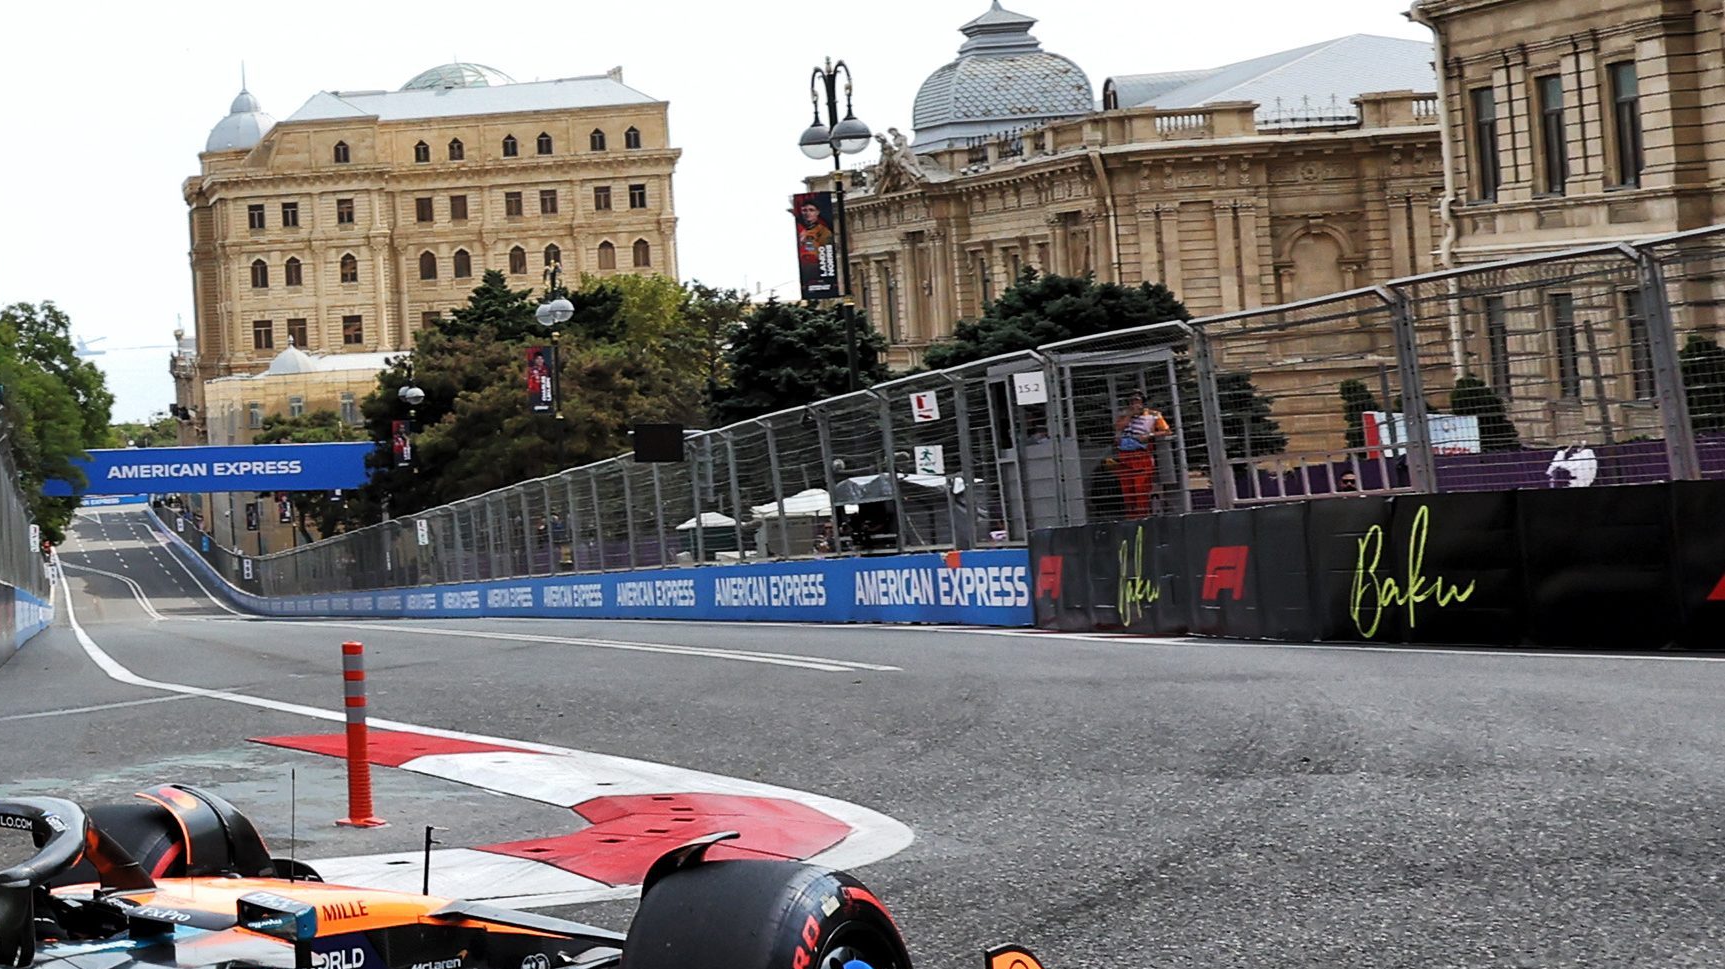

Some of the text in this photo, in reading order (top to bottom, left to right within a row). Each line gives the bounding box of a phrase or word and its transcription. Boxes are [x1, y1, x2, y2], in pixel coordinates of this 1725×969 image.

[818, 246, 828, 277] LANDO
[826, 244, 835, 277] NORRIS
[1018, 383, 1040, 394] 15.2
[107, 460, 302, 479] AMERICAN EXPRESS
[854, 566, 1028, 607] AMERICAN EXPRESS
[1350, 505, 1476, 639] Baku
[616, 579, 695, 607] AMERICAN EXPRESS
[715, 573, 825, 607] AMERICAN EXPRESS
[136, 905, 191, 922] FxPro
[322, 900, 369, 922] MILLE
